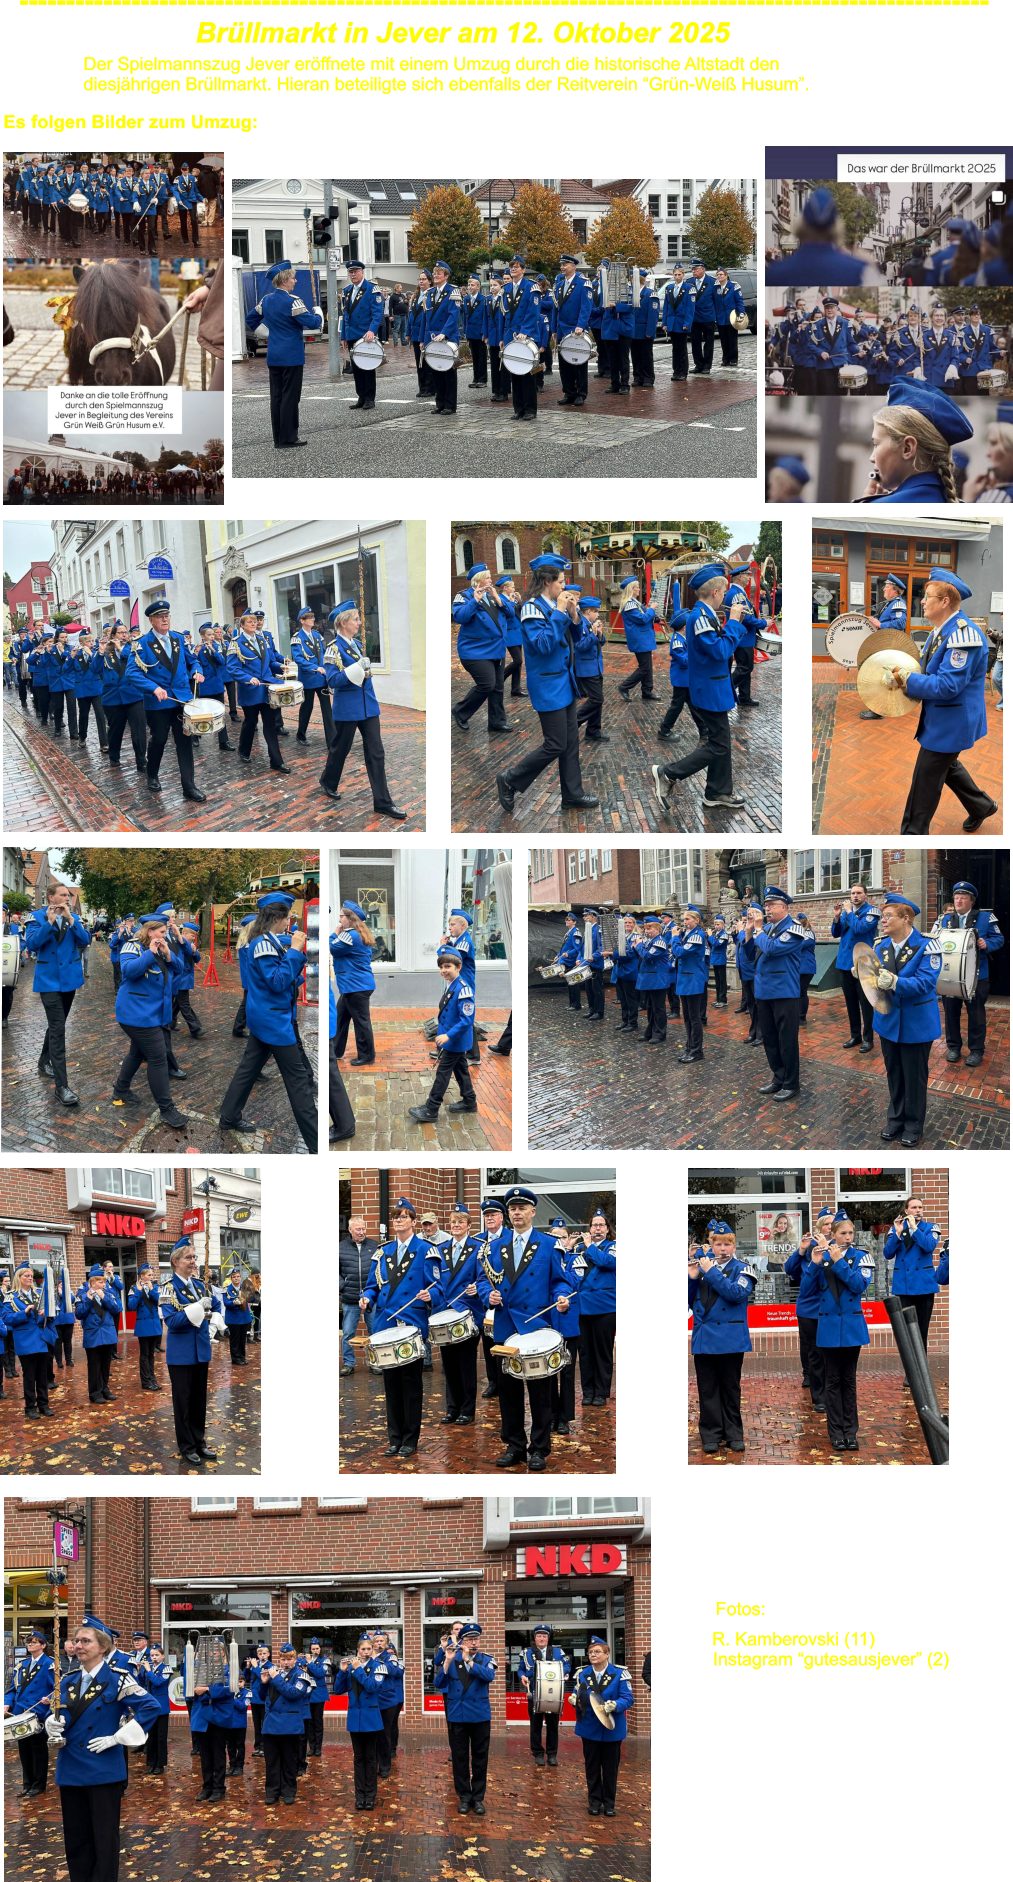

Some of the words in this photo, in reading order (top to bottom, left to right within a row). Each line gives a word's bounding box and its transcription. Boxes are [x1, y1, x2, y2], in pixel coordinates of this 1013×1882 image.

[828, 616, 862, 645] Spielmannszug
[235, 1211, 249, 1219] EWE
[96, 1212, 146, 1236] NKD
[184, 1217, 199, 1227] NKD
[33, 1243, 52, 1251] NKD
[762, 1243, 796, 1252] TRENDS
[60, 1526, 73, 1536] SPIEL
[525, 1544, 622, 1576] NKD
[298, 1600, 321, 1609] NKD
[431, 1597, 456, 1606] NKD
[170, 1602, 193, 1611] NKD
